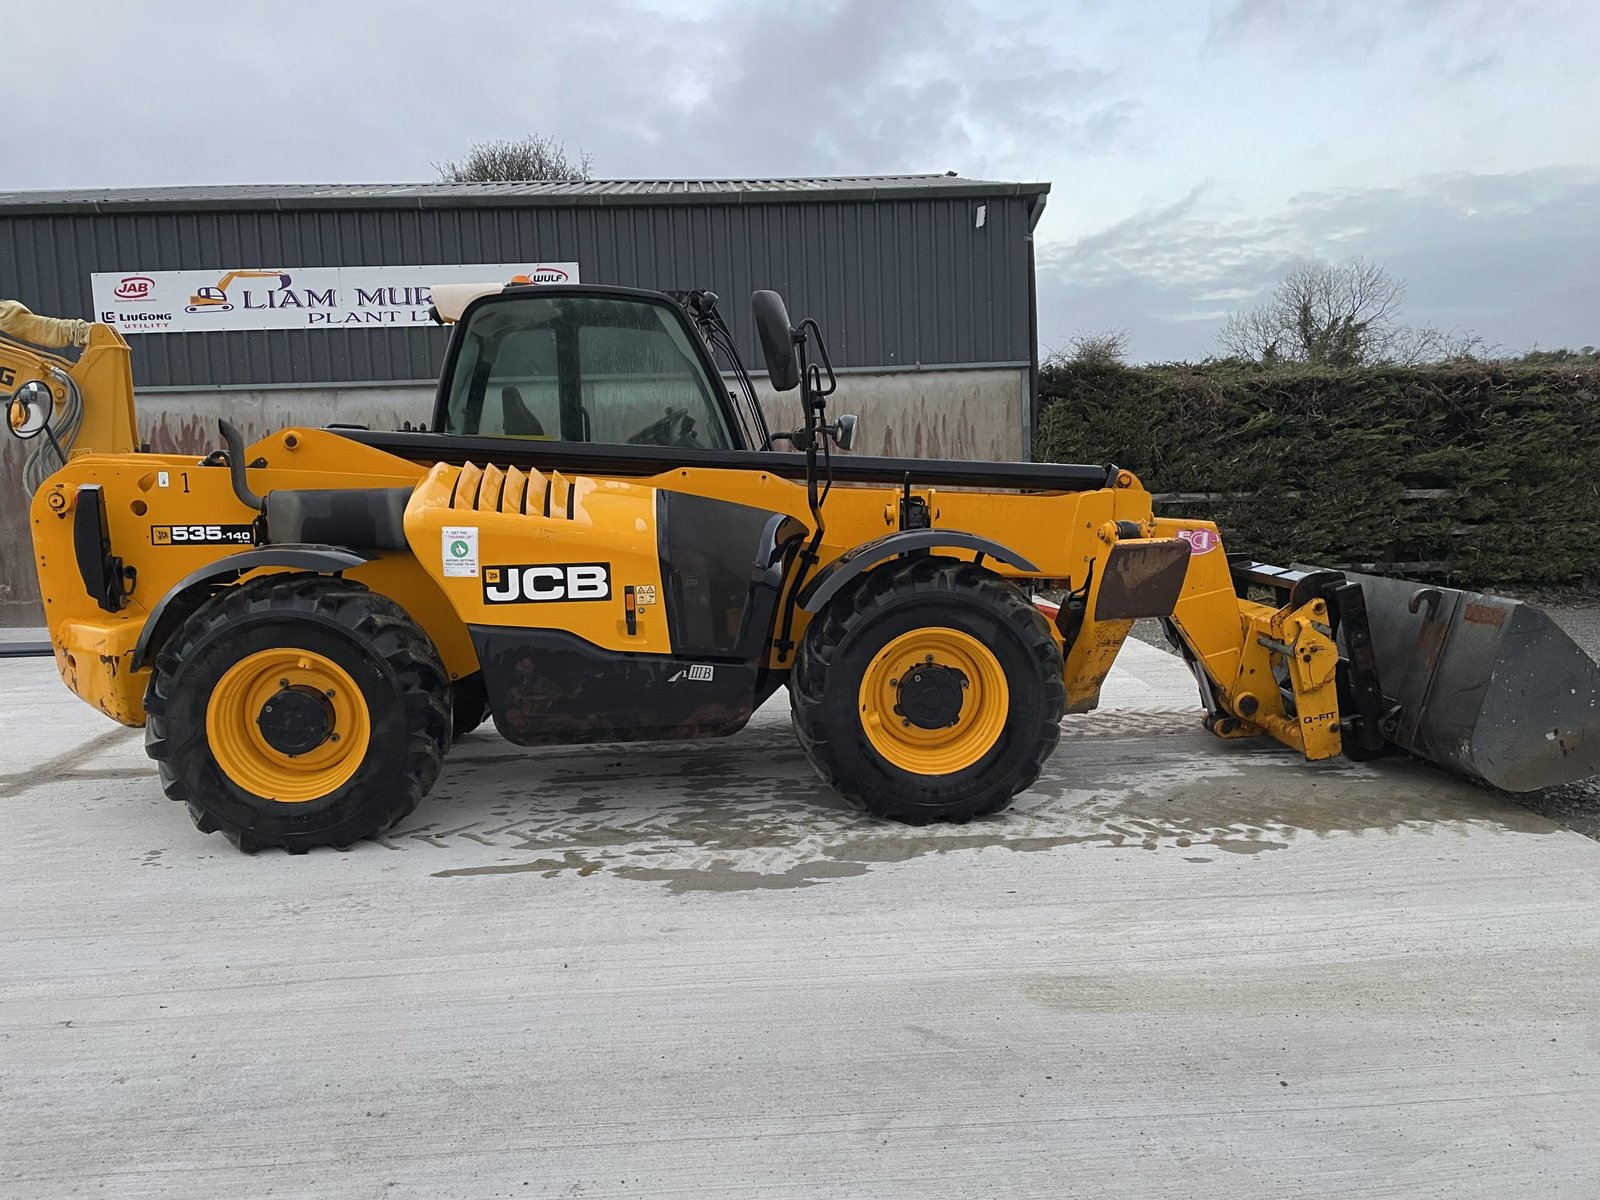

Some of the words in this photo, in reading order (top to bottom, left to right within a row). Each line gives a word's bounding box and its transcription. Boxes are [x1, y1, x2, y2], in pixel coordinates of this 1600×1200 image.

[533, 274, 562, 282] WULF
[118, 282, 148, 293] JAB
[242, 288, 337, 309] LIAM
[354, 286, 434, 306] MUR
[308, 311, 402, 323] PLANT
[411, 310, 434, 321] LT
[180, 472, 190, 493] 1
[172, 526, 251, 541] 535-140
[486, 566, 609, 601] JCB
[1303, 711, 1337, 724] Q-FIT
